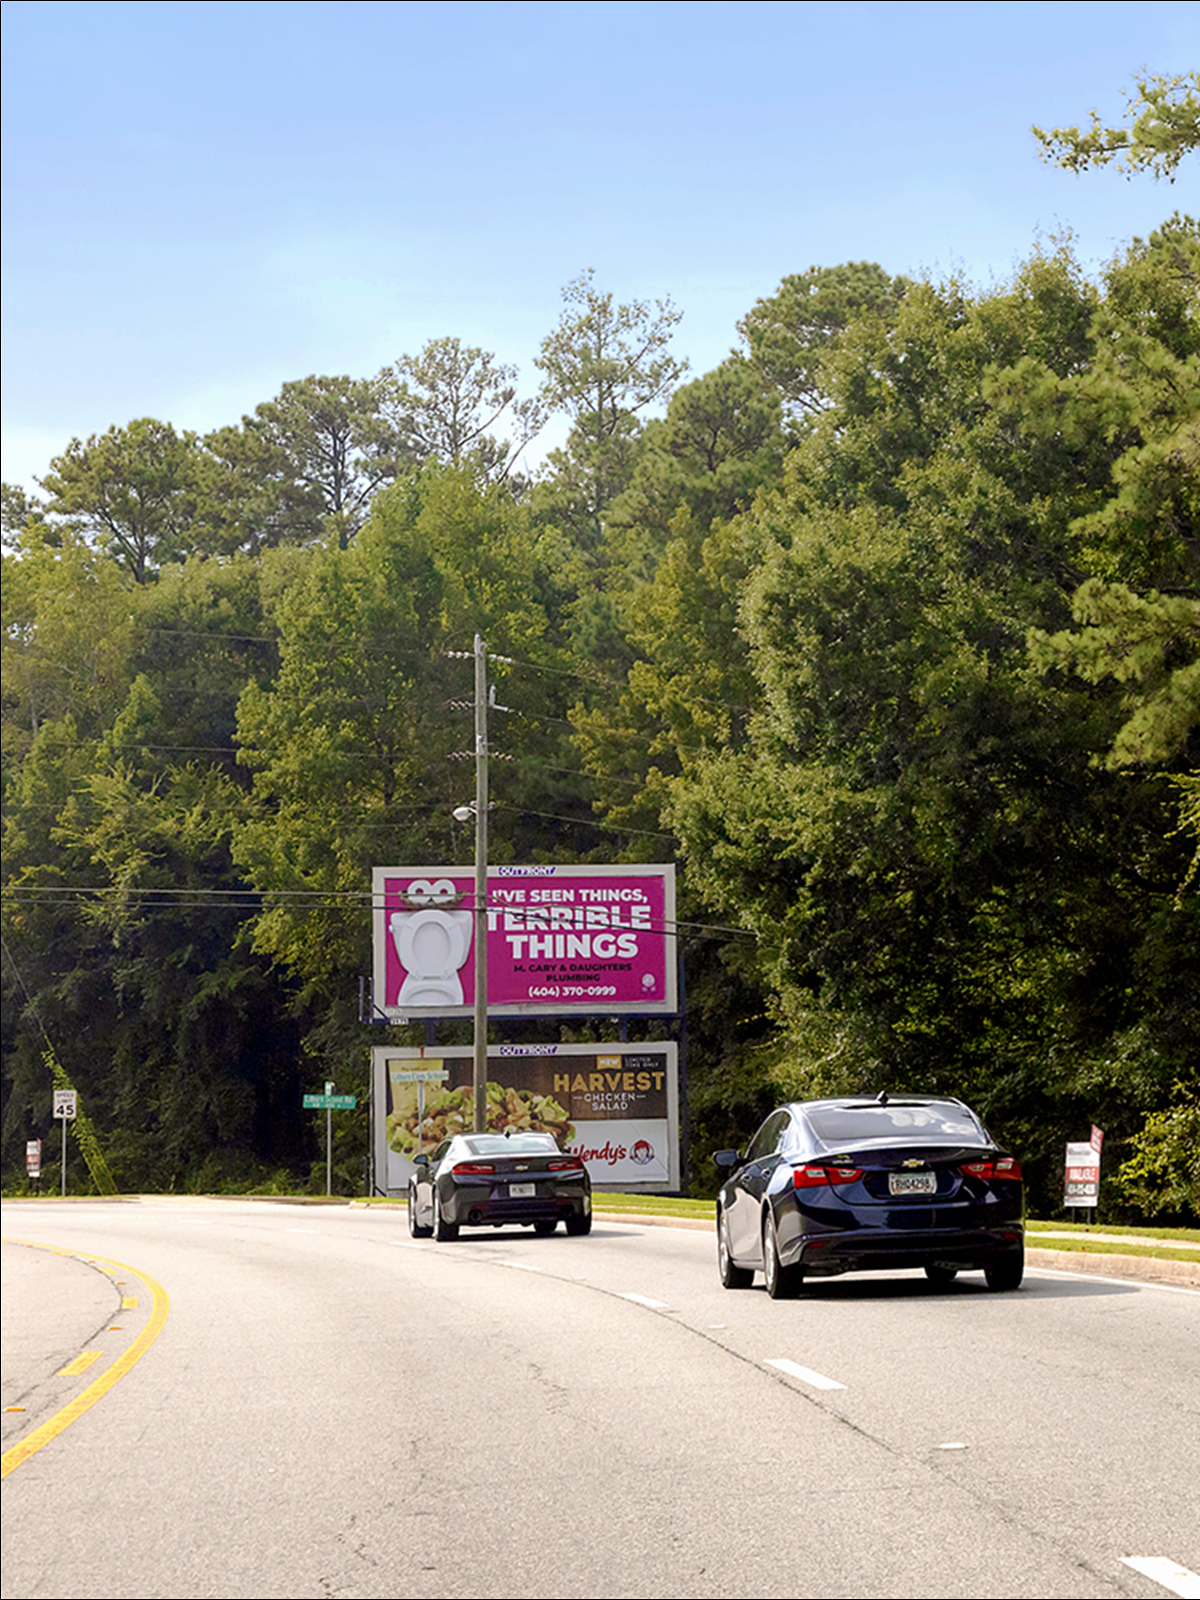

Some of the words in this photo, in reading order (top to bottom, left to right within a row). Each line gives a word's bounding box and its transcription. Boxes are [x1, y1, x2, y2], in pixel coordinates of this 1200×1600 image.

[492, 889, 525, 902] I'VE
[530, 889, 574, 902] SEEN
[579, 888, 648, 904] THINGS,
[486, 905, 651, 931] TERRIBLE
[506, 933, 639, 959] THINGS
[529, 964, 557, 972] CARY
[569, 963, 632, 971] DAUGHTERS
[546, 973, 601, 982] PLUMBING
[528, 986, 560, 997] (404)
[599, 1058, 619, 1066] NEW
[553, 1072, 665, 1092] HARVEST
[584, 1093, 635, 1102] CHICKEN
[56, 1105, 74, 1115] 45
[592, 1102, 628, 1111] SALAD
